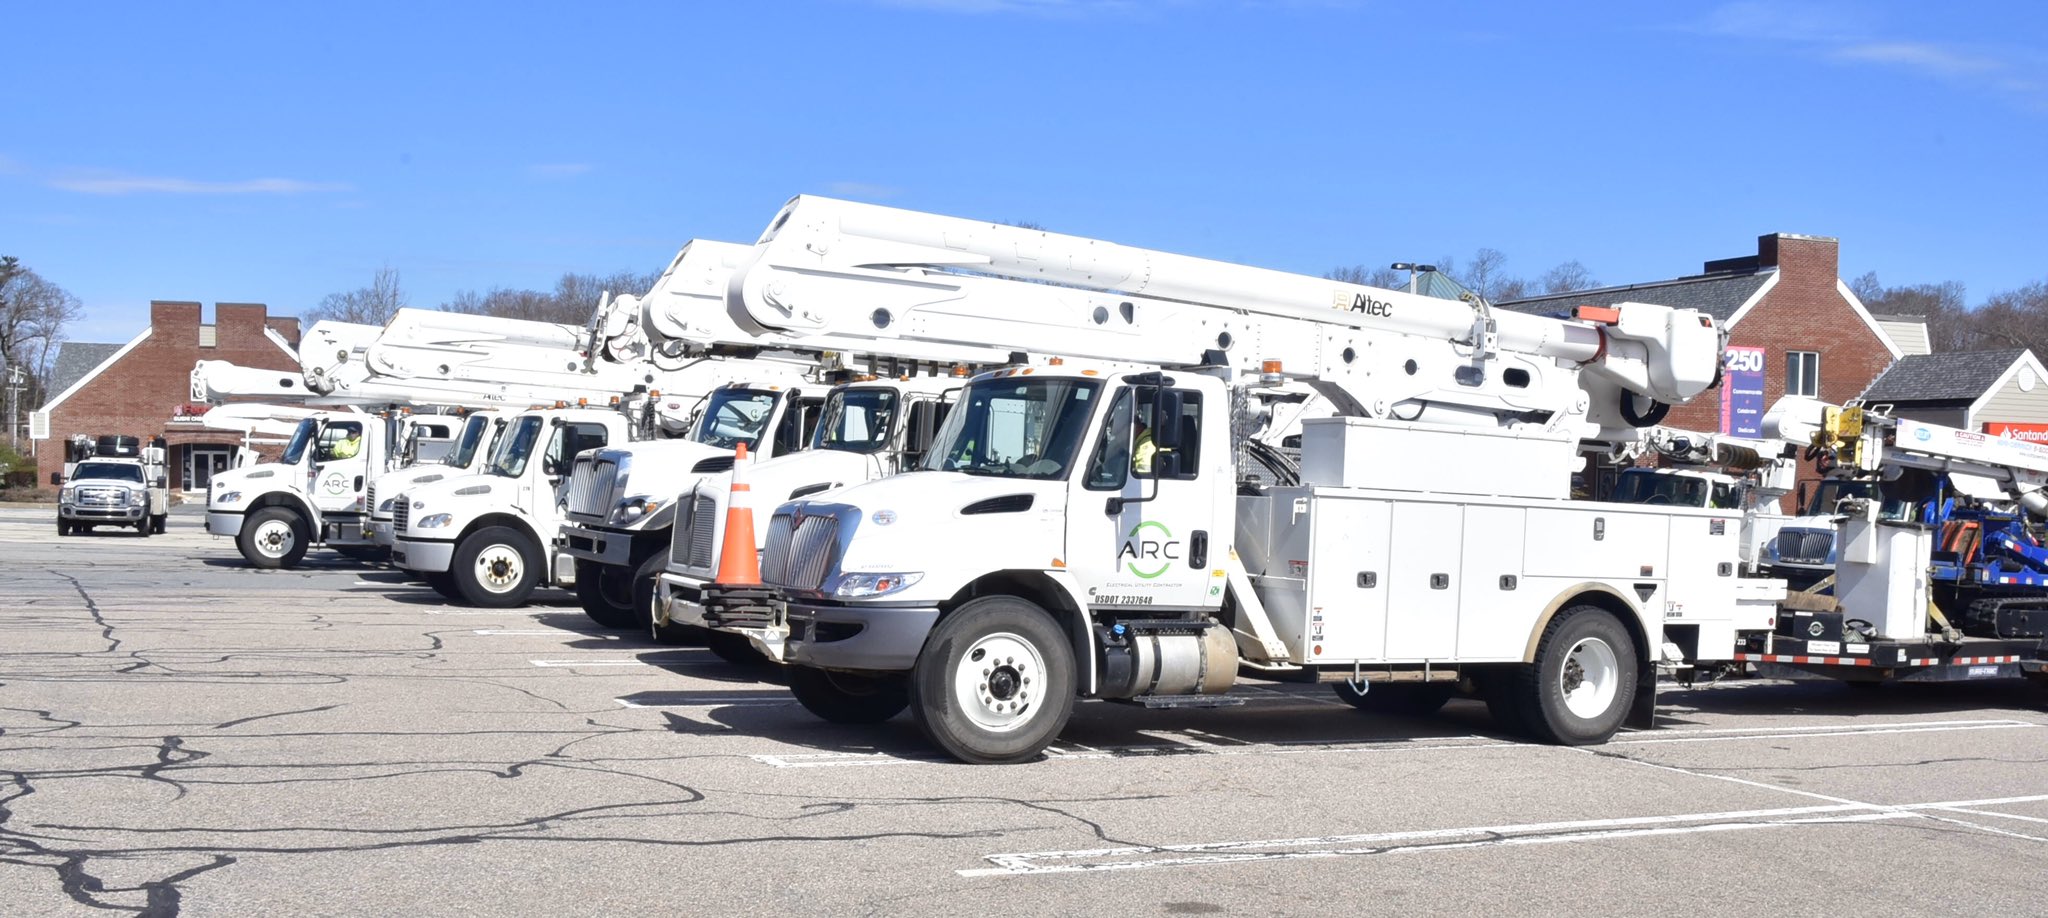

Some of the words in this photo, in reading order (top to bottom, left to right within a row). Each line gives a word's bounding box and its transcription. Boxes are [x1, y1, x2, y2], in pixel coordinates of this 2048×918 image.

[1350, 293, 1393, 318] Altec
[1726, 350, 1763, 371] 250
[323, 480, 349, 488] ARC
[1117, 540, 1180, 559] ARC
[1095, 595, 1119, 604] USDOT
[1121, 595, 1153, 605] 2337648
